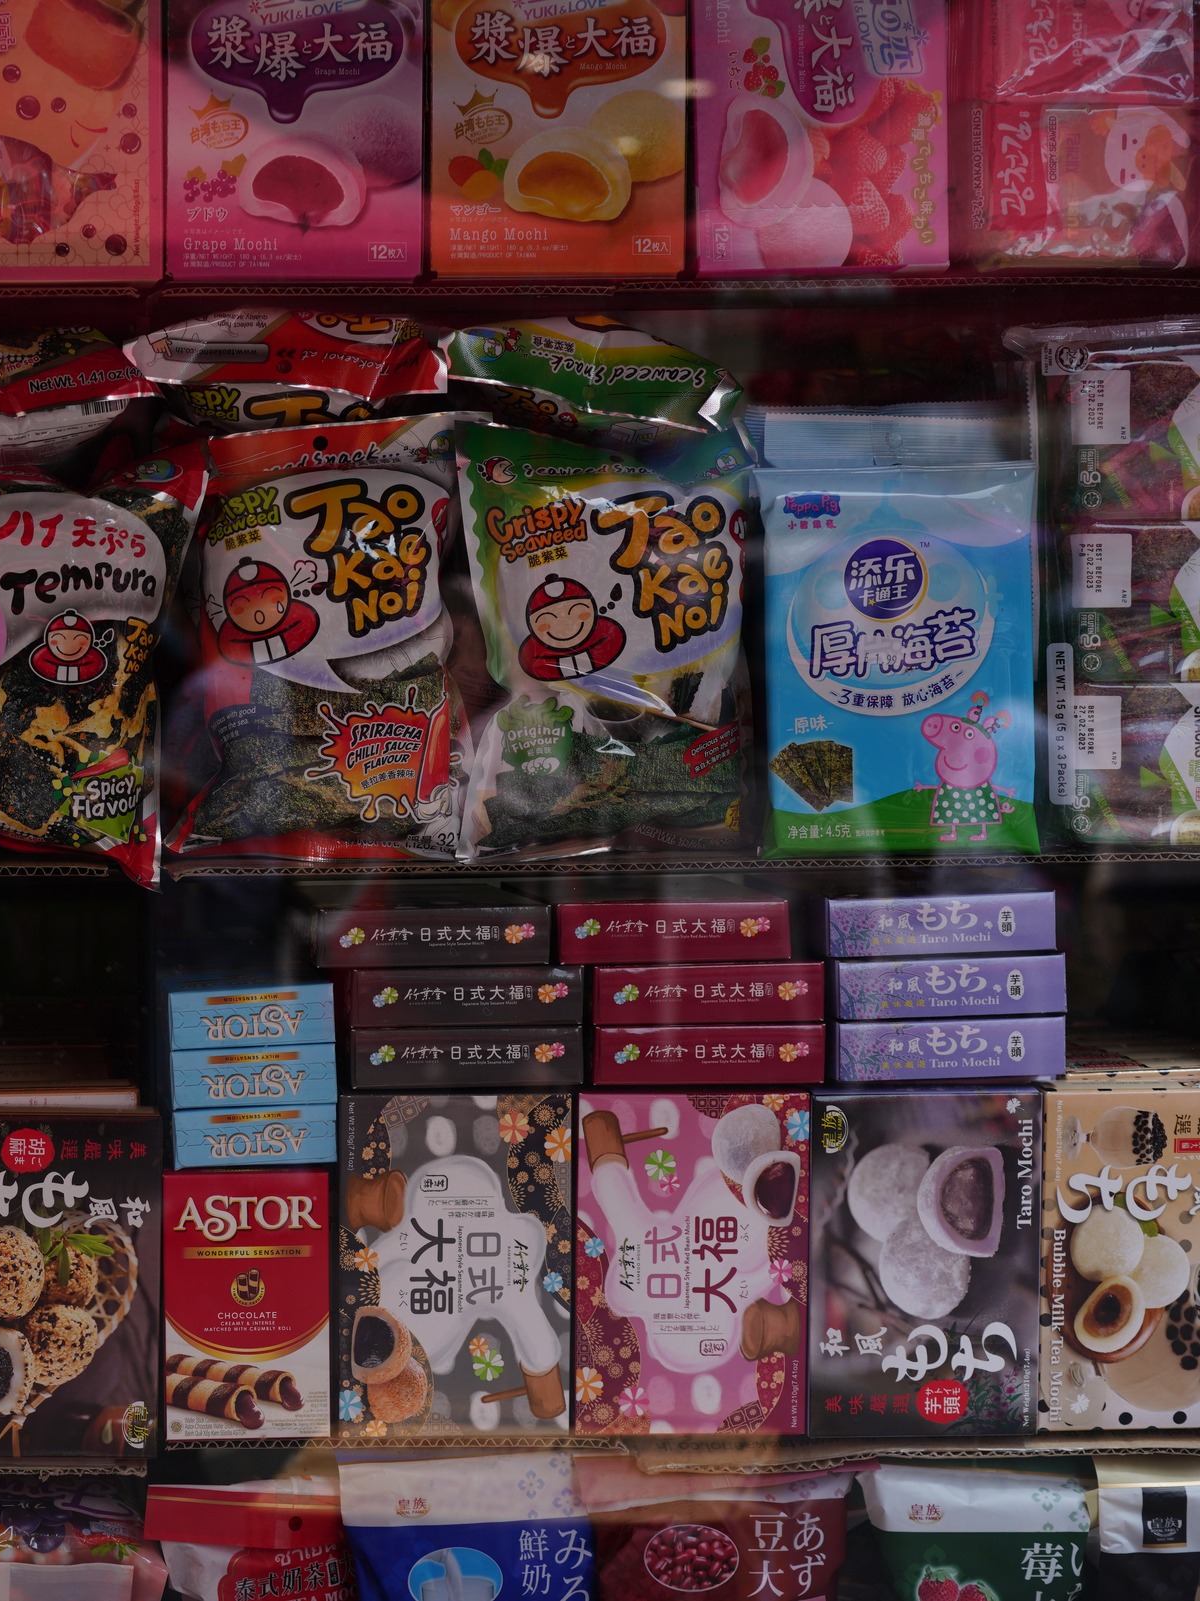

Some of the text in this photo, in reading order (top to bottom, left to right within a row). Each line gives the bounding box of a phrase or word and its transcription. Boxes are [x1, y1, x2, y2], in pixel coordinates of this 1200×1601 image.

[207, 16, 393, 82] 漿爆と大福
[1072, 13, 1083, 66] APEACH
[314, 67, 360, 76] Grape Mochi
[605, 62, 627, 70] Mochi
[729, 51, 742, 91] いちご
[973, 110, 983, 189] KAKAO FRIENDS
[1048, 116, 1058, 181] CRISPY SEAWEED
[997, 120, 1035, 217] 광천김
[183, 237, 278, 253] Grape Mochi
[450, 227, 548, 243] Mango Mochi
[370, 244, 405, 260] 12枚入
[1087, 450, 1095, 471] GLUTEN
[284, 479, 424, 558] Tao
[785, 495, 839, 515] Peppa Pig
[486, 499, 587, 543] Crispy
[591, 492, 725, 573] Tao
[225, 528, 262, 551] 脆紫菜
[500, 525, 588, 563] Seaweed
[330, 532, 430, 599] Kae
[528, 546, 568, 568] 脆紫菜
[850, 552, 916, 590] 添乐
[1095, 543, 1103, 593] BEST BEFORE
[0, 562, 156, 615] Tempura
[635, 543, 732, 614] Kae
[858, 584, 907, 606] 卡通王
[127, 617, 154, 648] Tao
[350, 723, 422, 747] SRIRACHA
[507, 724, 566, 743] Original
[511, 736, 559, 754] Flavour
[347, 741, 420, 769] CHILLI SAUCE
[364, 753, 411, 774] FLAVOUR
[72, 788, 141, 818] Flavour
[86, 776, 135, 801] Spicy
[919, 932, 991, 943] Taro Mochi
[1001, 911, 1012, 933] 芋頭
[1010, 974, 1021, 996] 芋頭
[928, 995, 1000, 1007] Taro Mochi
[200, 1004, 304, 1041] ASTOR
[450, 1044, 522, 1060] 日式大福
[694, 1043, 766, 1059] 日式大福
[929, 1056, 1001, 1068] Taro Mochi
[1010, 1036, 1022, 1058] 芋頭
[201, 1064, 305, 1100] ASTOR
[204, 1122, 307, 1159] ASTOR
[1017, 1119, 1033, 1229] Taro Mochi
[173, 1195, 322, 1242] ASTOR
[410, 1218, 457, 1315] 大福
[466, 1232, 504, 1305] 日式
[645, 1226, 682, 1299] 日式
[692, 1216, 738, 1313] 大福
[1049, 1229, 1066, 1422] Bubble Milk Tea Mochi
[924, 1396, 960, 1415] 芋頭
[398, 1497, 427, 1510] 皇族
[910, 1503, 941, 1517] 皇族
[518, 1529, 551, 1595] 鮮奶
[747, 1512, 789, 1597] 豆大
[790, 1512, 825, 1597] あず
